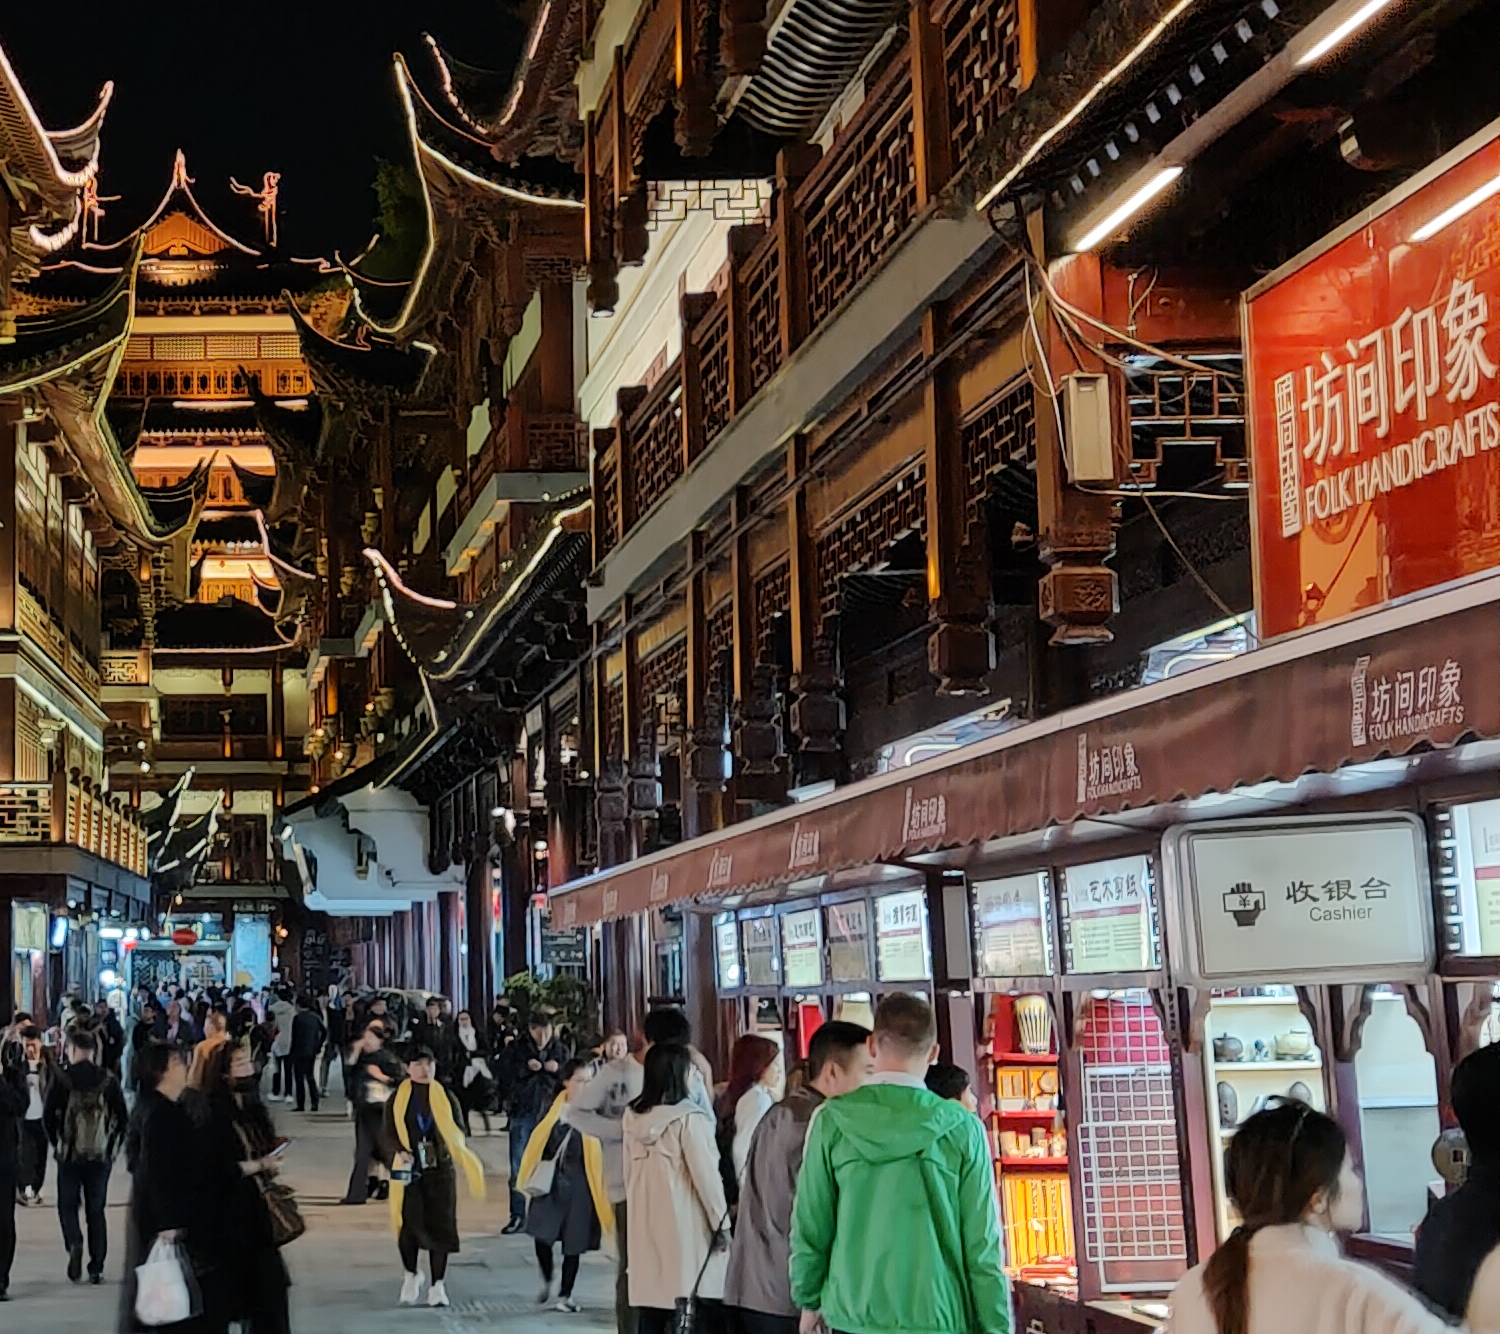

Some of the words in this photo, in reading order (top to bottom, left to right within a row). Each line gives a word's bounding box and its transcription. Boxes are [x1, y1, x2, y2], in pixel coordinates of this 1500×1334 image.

[1301, 278, 1499, 466] 坊间印象
[1305, 469, 1353, 524] FOLK
[1354, 401, 1500, 505] HANDICRAFTS
[1371, 659, 1462, 723] 坊间印象
[1285, 876, 1392, 905] 收银台
[1309, 906, 1373, 922] Cashier
